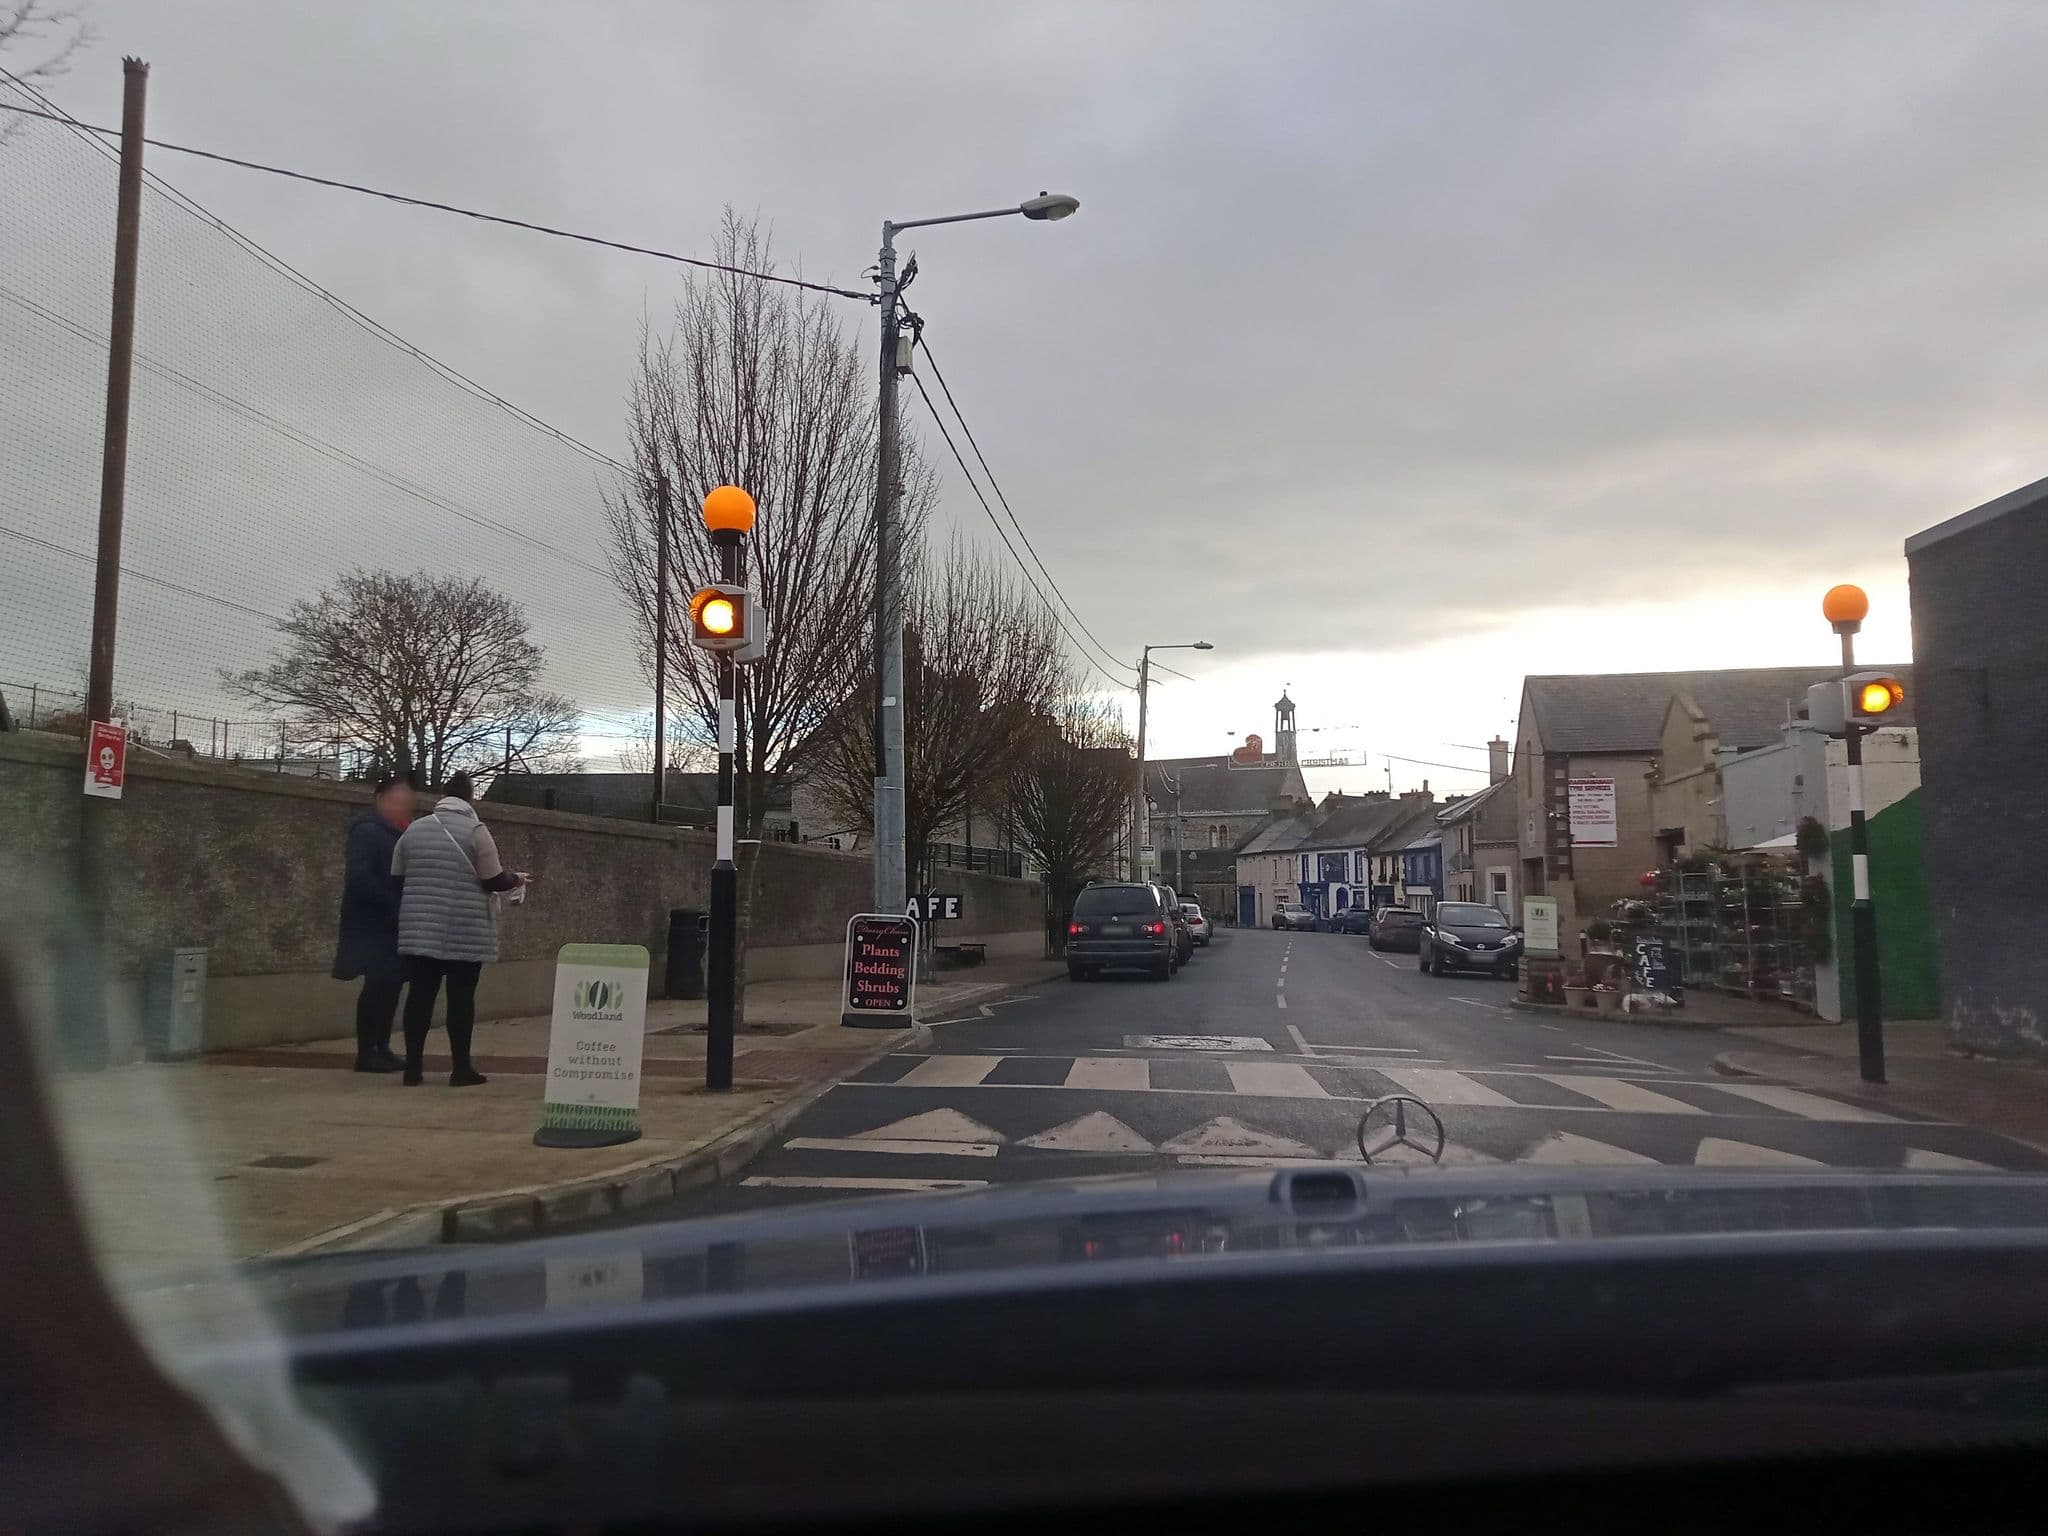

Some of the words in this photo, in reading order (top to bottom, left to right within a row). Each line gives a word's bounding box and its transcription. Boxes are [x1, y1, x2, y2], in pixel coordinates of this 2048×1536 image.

[906, 897, 958, 918] AFE
[862, 944, 900, 957] Plants
[854, 962, 905, 979] Bedding
[1636, 943, 1655, 988] CAFE
[856, 980, 900, 993] Shrubs
[865, 998, 891, 1007] OPEN
[572, 1010, 623, 1021] Woodland
[576, 1040, 617, 1052] Coffee
[568, 1055, 622, 1066] without
[553, 1067, 633, 1081] Compromise
